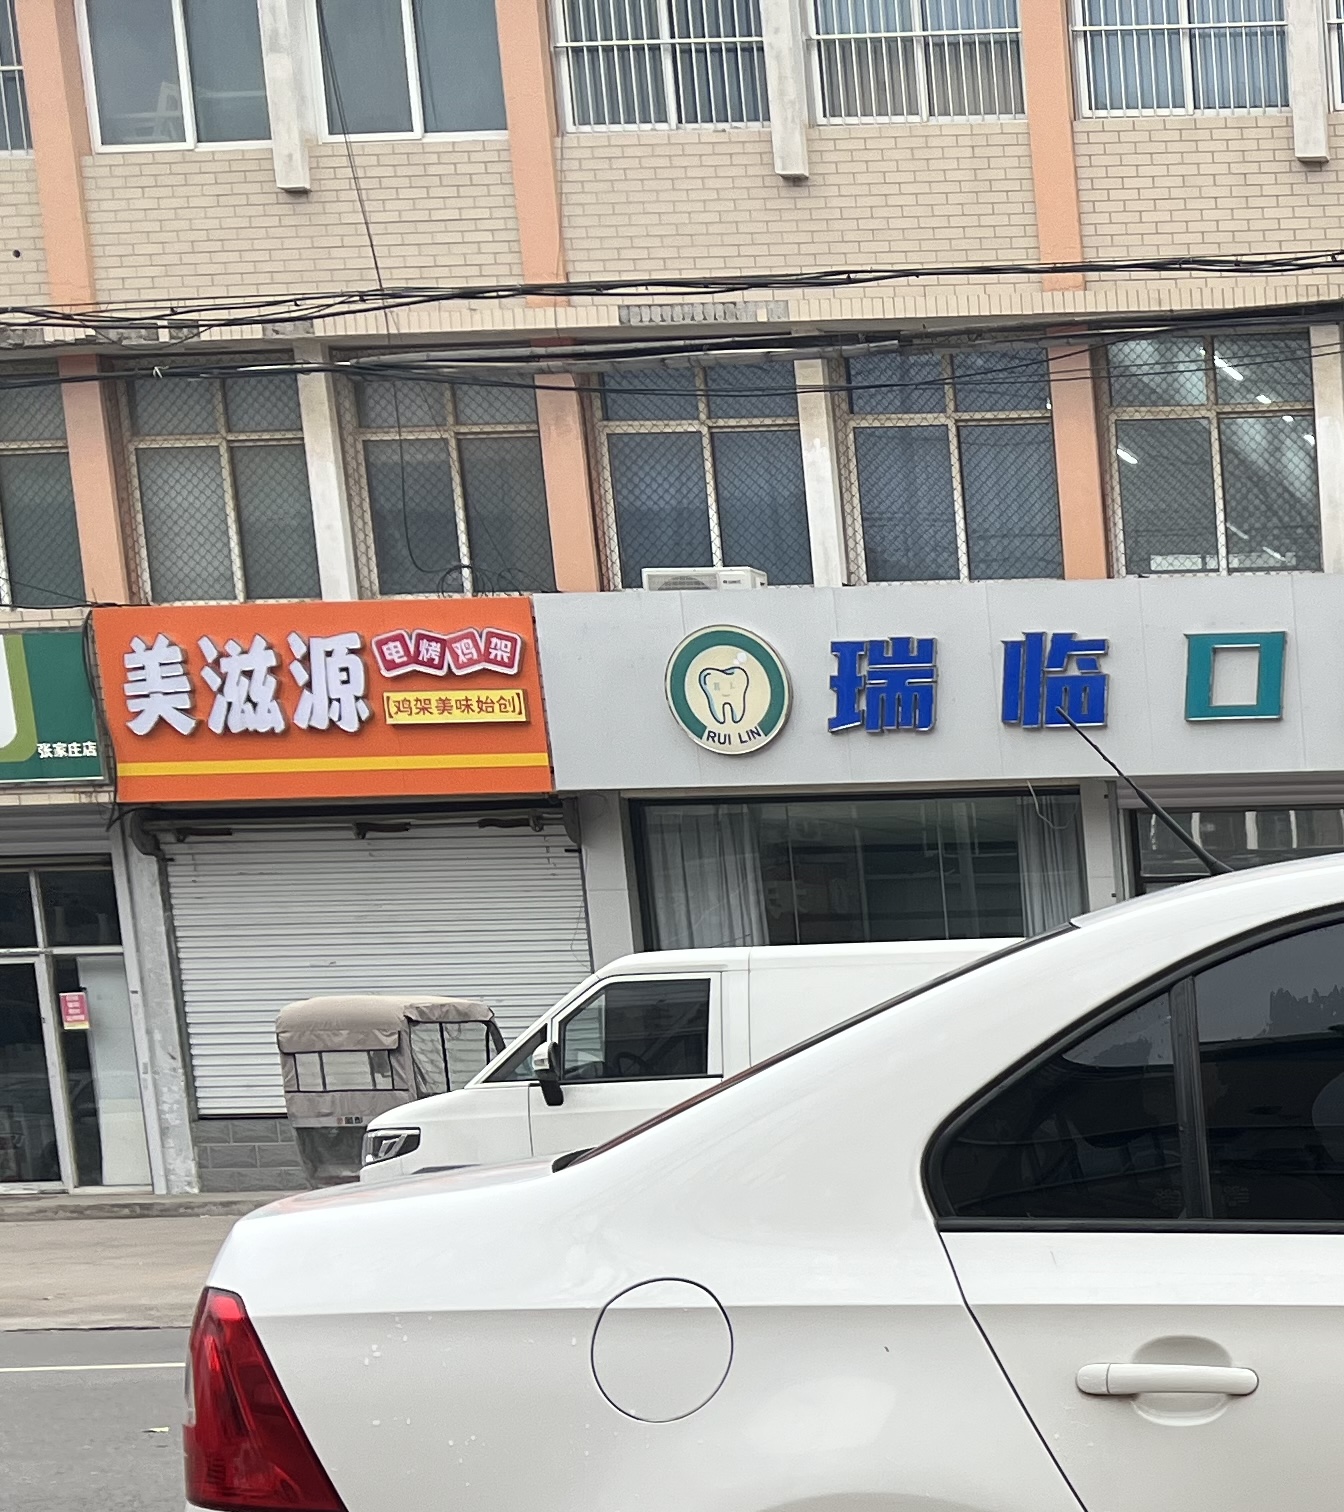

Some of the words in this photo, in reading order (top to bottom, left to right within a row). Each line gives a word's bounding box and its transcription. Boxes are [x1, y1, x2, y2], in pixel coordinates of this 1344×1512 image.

[381, 637, 512, 665] 电烤鸡架
[123, 631, 373, 736] 美滋源
[706, 730, 732, 746] RUI
[737, 726, 762, 744] LIN
[37, 741, 98, 759] 张家庄店
